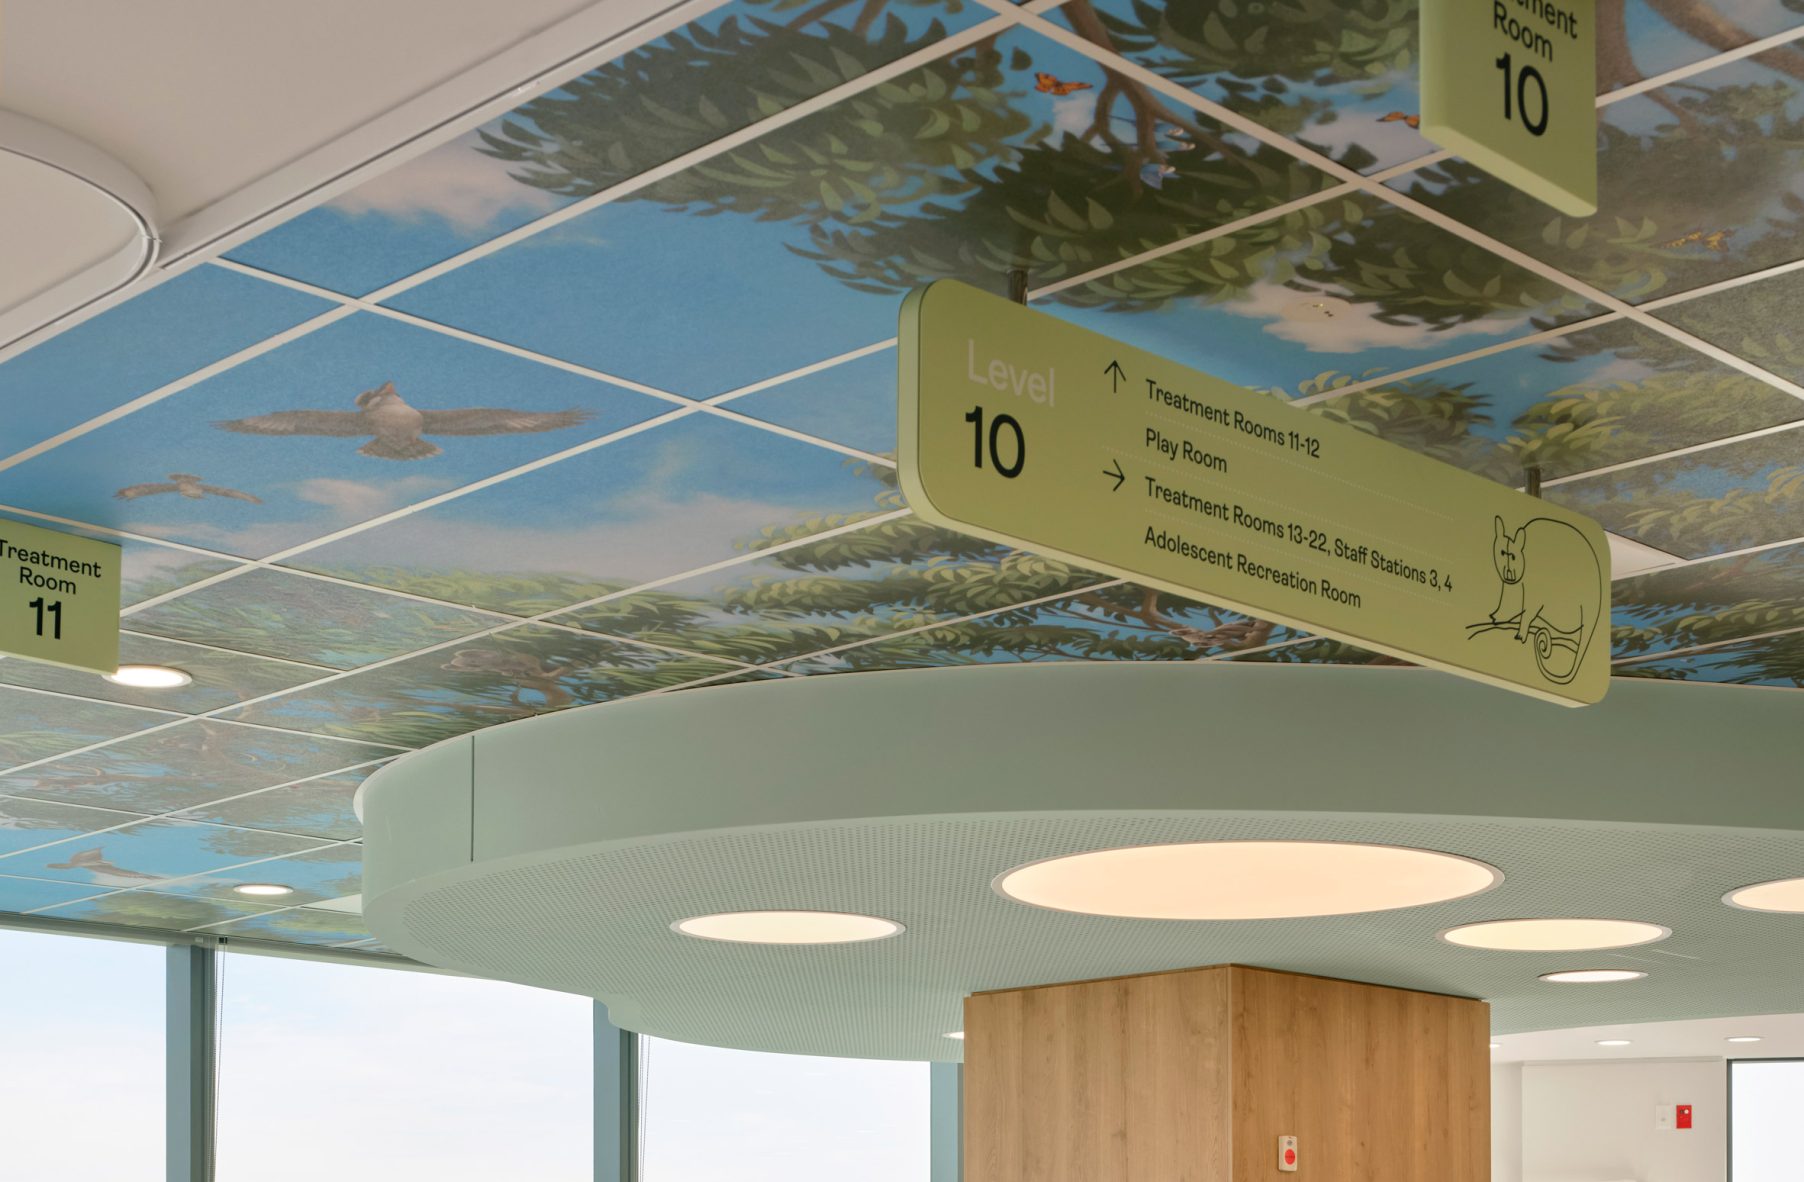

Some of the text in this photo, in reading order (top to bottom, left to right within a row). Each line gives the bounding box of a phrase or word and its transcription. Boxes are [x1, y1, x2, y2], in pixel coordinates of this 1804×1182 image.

[1493, 0, 1553, 62] Room
[1516, 0, 1578, 39] ment
[1496, 52, 1549, 137] 10
[967, 337, 1055, 407] Level
[965, 405, 1026, 479] 10
[1145, 378, 1320, 459] Treatment Rooms 11-12
[1146, 428, 1228, 473] Play Room
[0, 538, 102, 578] Treatment
[1144, 525, 1361, 609] Adolescent Recreation Room
[1145, 476, 1453, 593] Treatment Rooms 13-22, Staff Stations 3, 4
[19, 566, 77, 595] Room
[29, 597, 62, 640] 11
